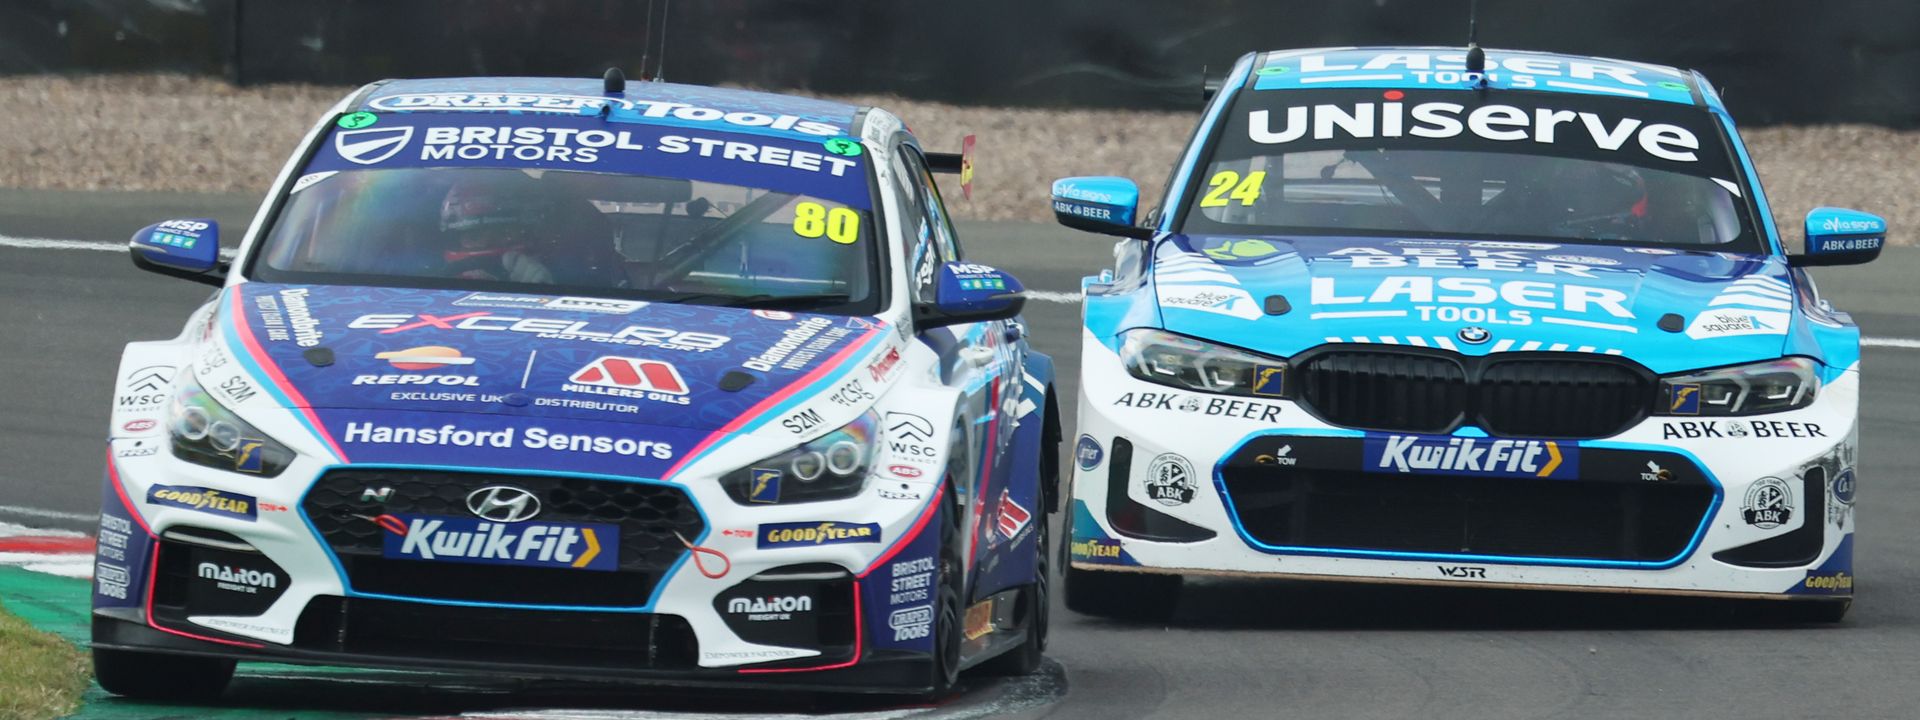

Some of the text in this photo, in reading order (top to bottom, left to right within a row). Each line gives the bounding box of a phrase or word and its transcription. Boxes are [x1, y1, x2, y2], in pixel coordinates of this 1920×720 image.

[1301, 54, 1647, 87] LASER
[391, 95, 605, 109] DRAPER
[637, 99, 839, 136] Tools
[420, 145, 598, 163] MOTORS
[424, 127, 857, 177] BRISTOL STREET
[1200, 170, 1267, 208] 24
[1055, 202, 1112, 220] ABK BEER
[158, 219, 209, 232] MSP
[793, 202, 860, 246] 80
[1822, 238, 1879, 250] ABK BEER
[1327, 247, 1530, 262] ABK
[948, 263, 995, 275] MSP
[1351, 255, 1600, 278] BEER
[1310, 276, 1636, 319] LASER
[1414, 306, 1532, 326] TOOLS
[347, 311, 732, 348] EXCELR8
[535, 334, 714, 353] MOTORSPORT
[741, 317, 833, 372] Diamondbrite
[220, 375, 257, 405] S2M
[351, 375, 480, 386] REPSOL
[120, 394, 166, 406] WSC
[391, 392, 641, 414] EXCLUSIVE UK DISTRIBUTOR
[561, 384, 691, 405] MILLERS OILS
[1113, 392, 1282, 423] ABK BEER
[782, 408, 825, 434] S2M
[1663, 421, 1828, 440] ABK BEER
[344, 422, 674, 460] Hansford Sensors
[889, 441, 936, 457] WSC
[1277, 457, 1297, 466] TOW
[1640, 472, 1659, 481] TOW
[153, 489, 249, 514] GOODYEAR
[1156, 487, 1185, 501] ABK
[1754, 510, 1782, 523] ABK
[767, 523, 871, 545] GOODYEAR
[892, 556, 935, 578] BRISTOL
[1437, 565, 1487, 578] WSR
[891, 572, 932, 592] STREET
[890, 589, 928, 605] MOTORS
